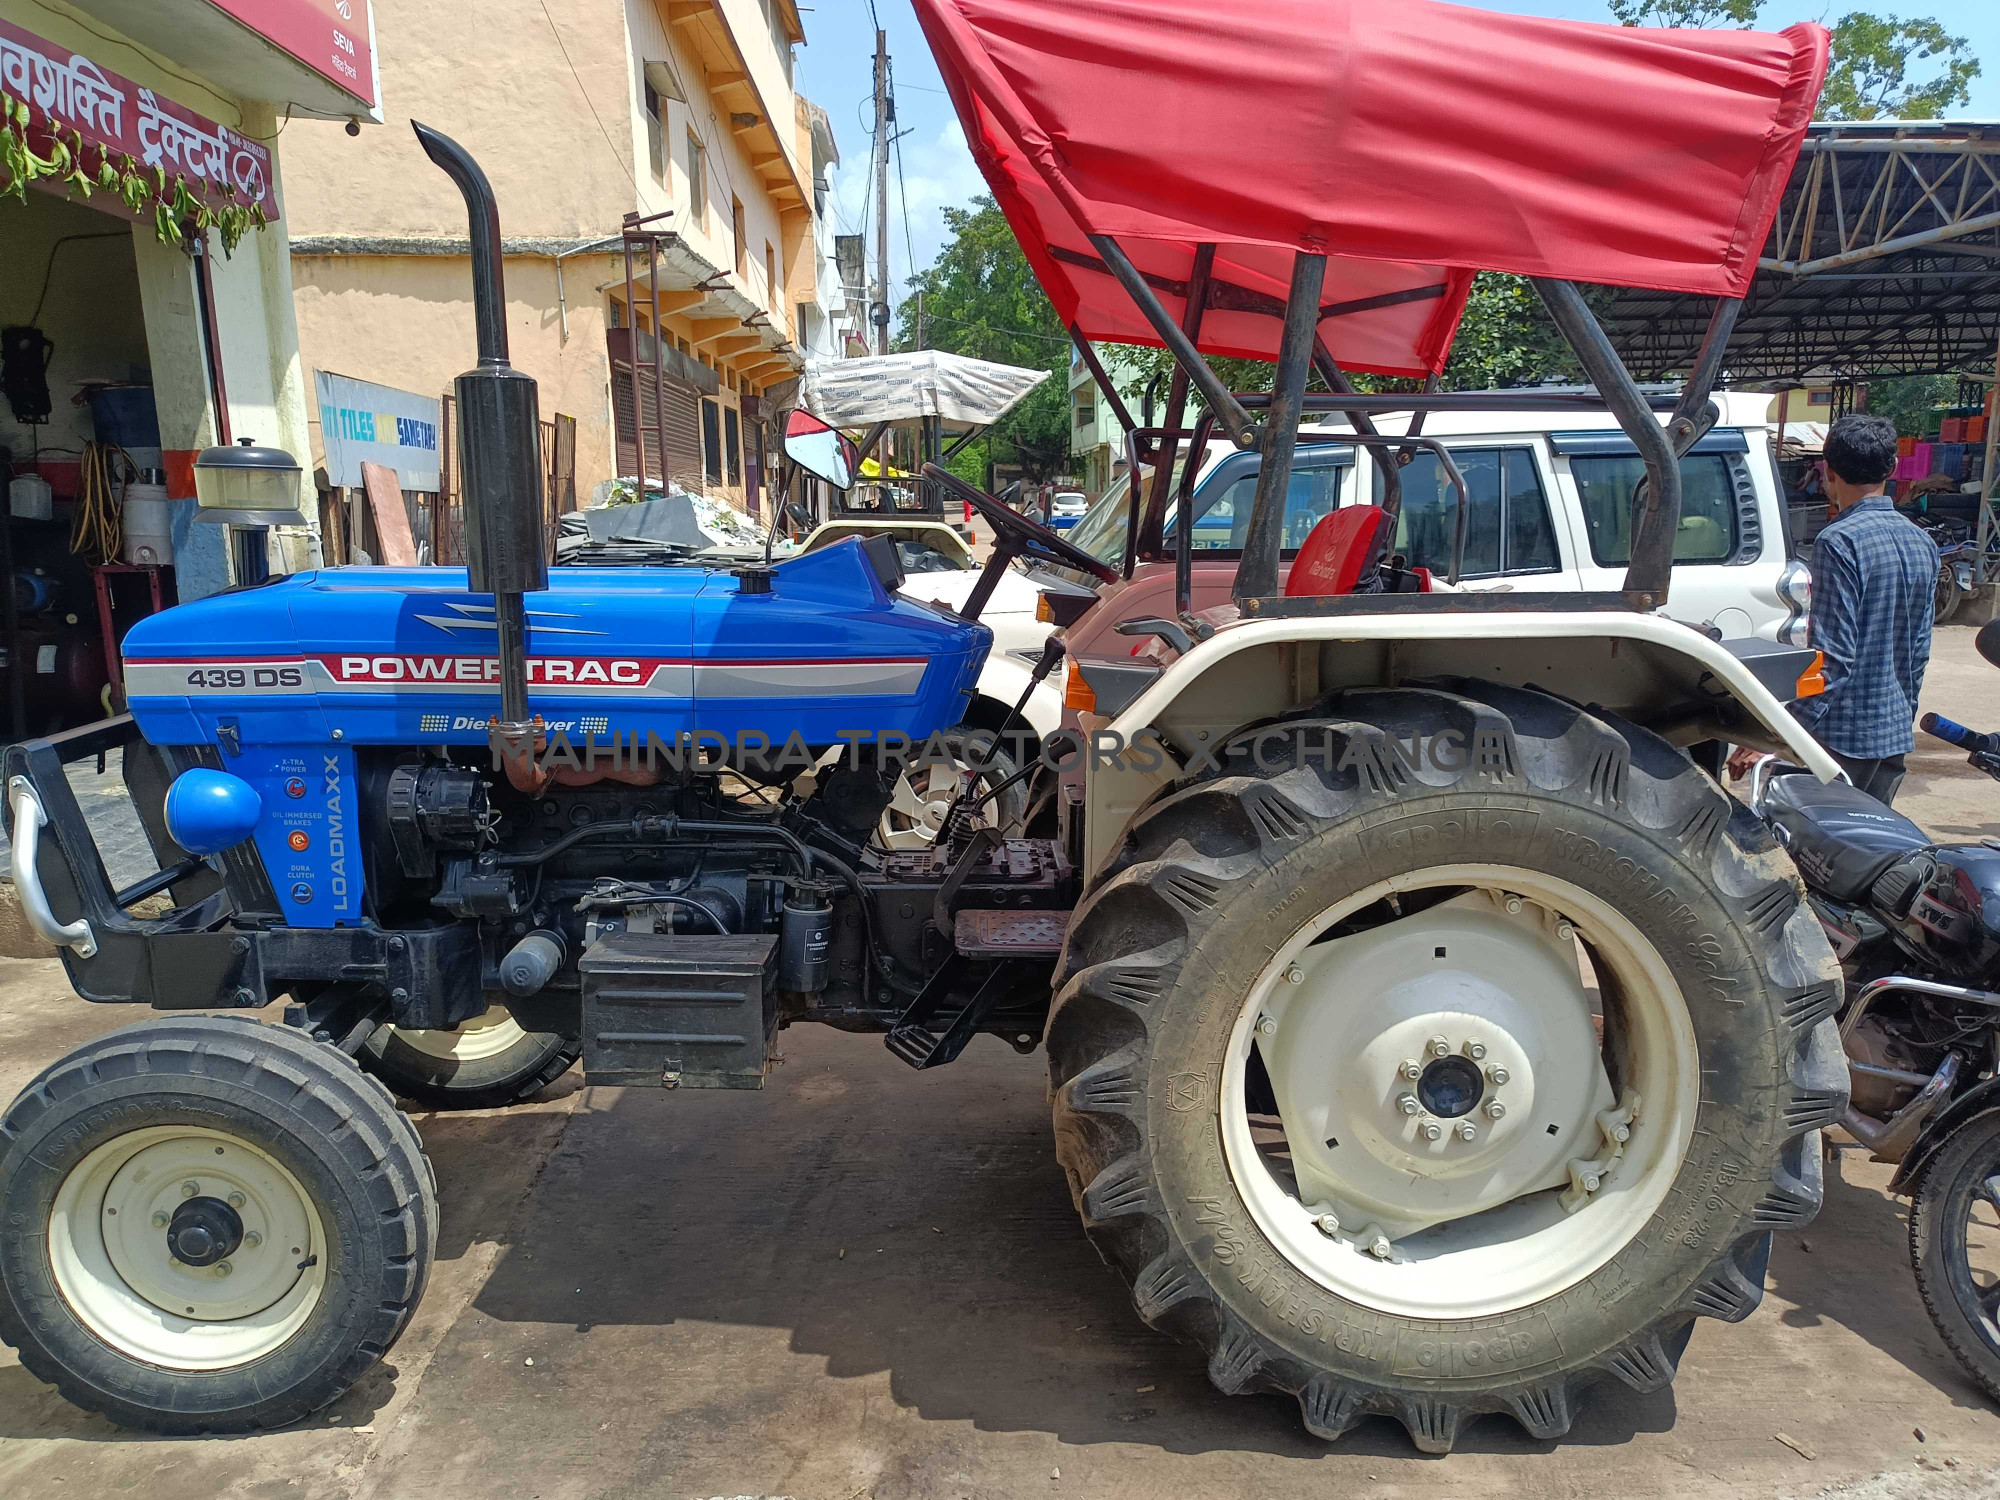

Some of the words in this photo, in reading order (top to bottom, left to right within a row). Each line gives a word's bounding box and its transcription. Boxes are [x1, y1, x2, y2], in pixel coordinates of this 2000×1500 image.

[333, 29, 355, 57] SEVA
[0, 37, 125, 140] वशक्ति
[340, 408, 375, 442] TILES
[187, 669, 246, 688] 439
[253, 668, 302, 687] DS
[281, 758, 305, 766] X-TRA
[323, 755, 348, 910] LOADMAXX
[1385, 809, 1514, 867] apollo
[1550, 827, 1700, 936] KRISHAK
[1685, 933, 1747, 1007] Gold
[1187, 1196, 1245, 1266] Gold
[1681, 1160, 1741, 1249] 13.6-28
[1238, 1259, 1384, 1360] KRISHAK
[1416, 1326, 1536, 1377] apollo
